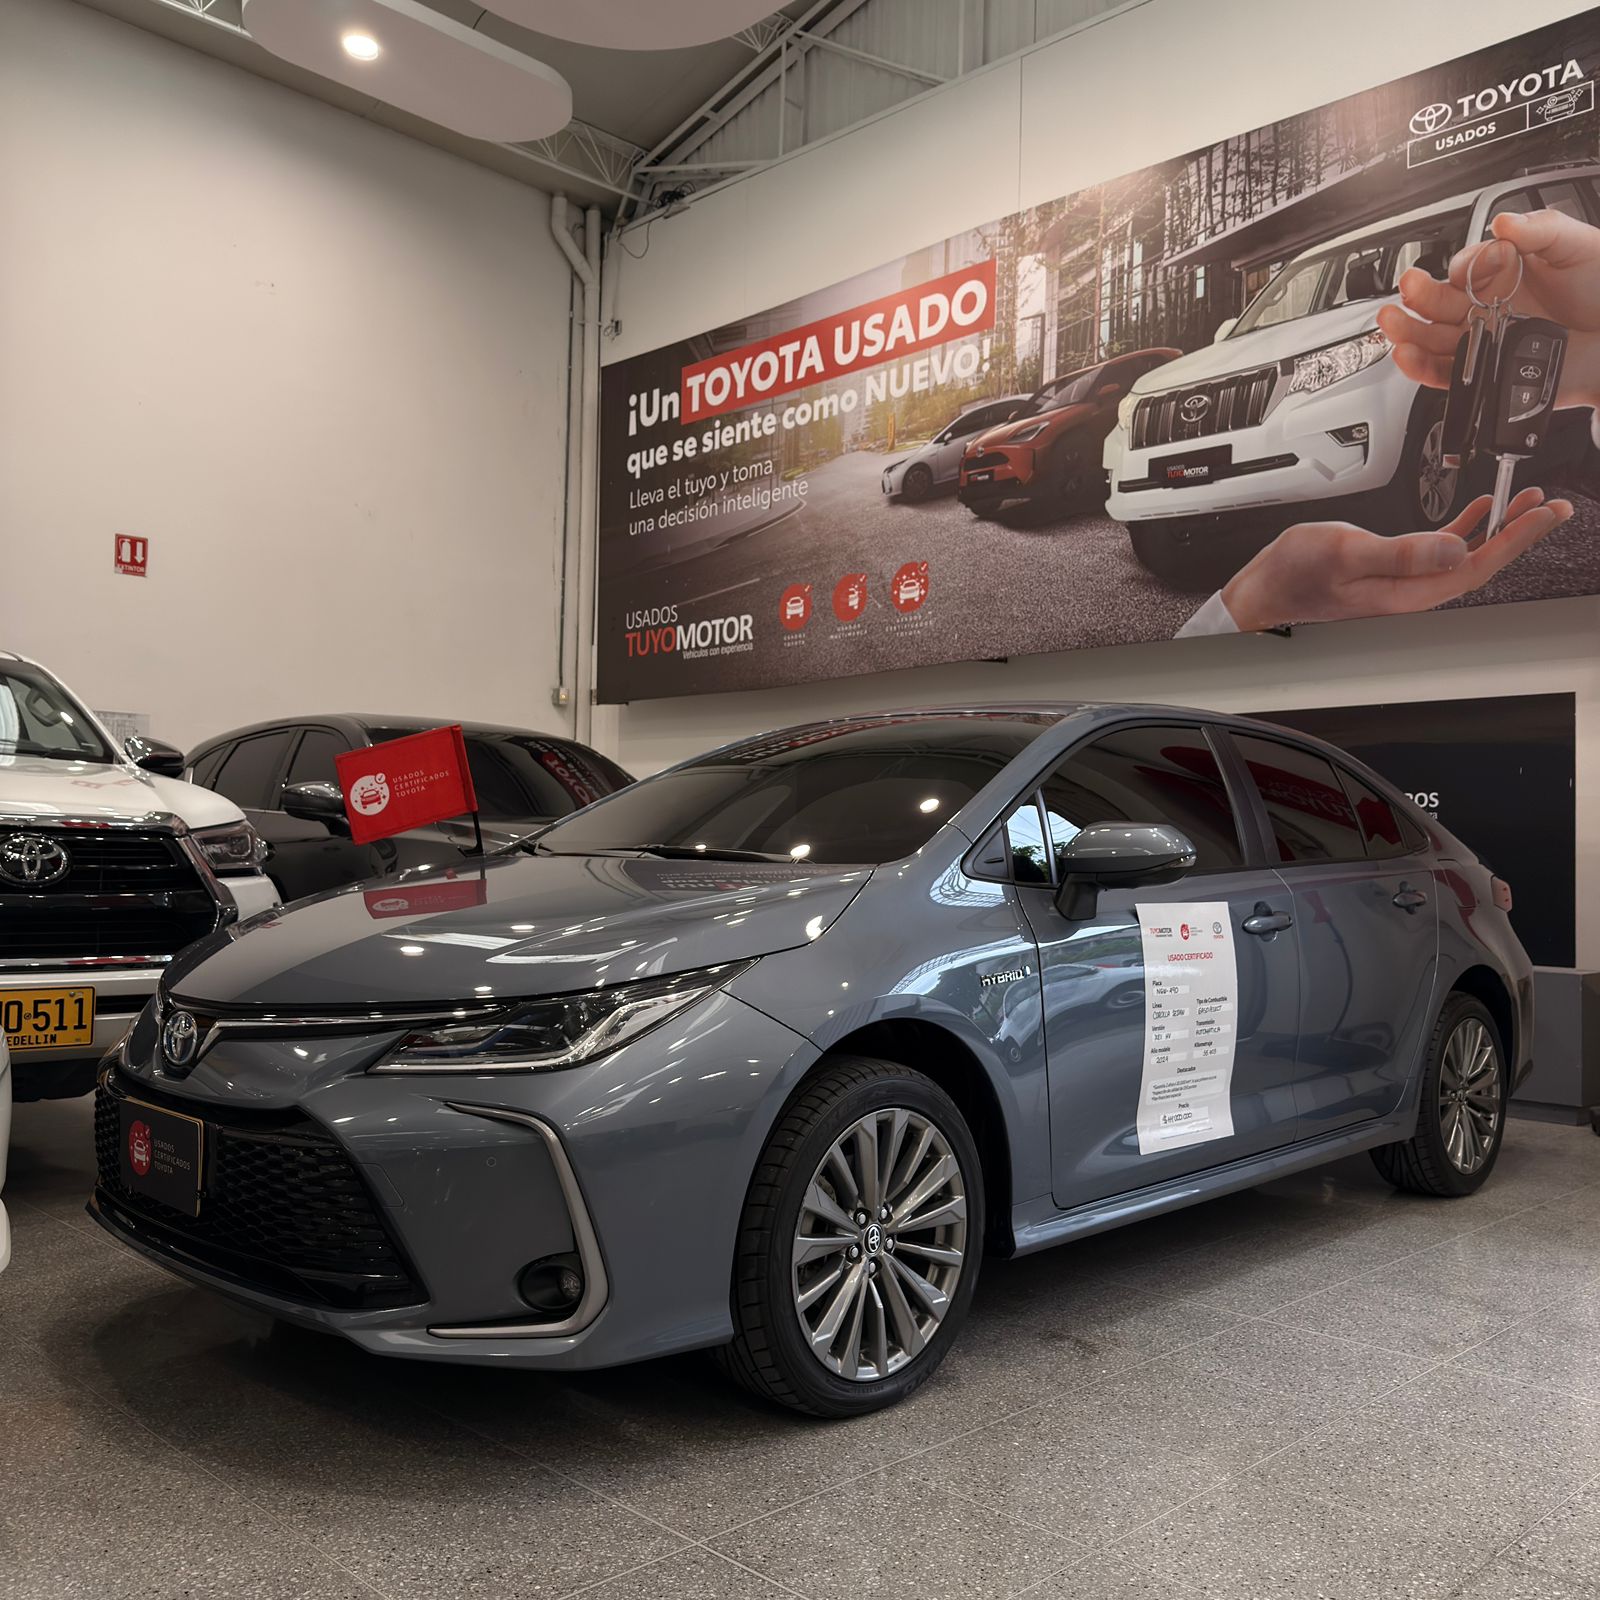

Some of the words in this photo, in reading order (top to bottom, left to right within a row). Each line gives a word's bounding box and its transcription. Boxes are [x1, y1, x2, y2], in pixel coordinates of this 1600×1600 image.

[1456, 58, 1584, 118] TOYOTA
[1435, 121, 1497, 151] USADOS
[628, 387, 680, 437] ¡Un
[686, 335, 825, 413] TOYOTA
[834, 279, 988, 366] USADO
[626, 444, 669, 480] que
[672, 436, 698, 462] se
[702, 411, 777, 454] siente
[782, 389, 858, 430] como
[865, 338, 991, 406] NUEVO!
[629, 488, 664, 510] Lleva
[668, 478, 681, 500] el
[684, 474, 717, 498] tuyo
[719, 471, 729, 491] y
[733, 459, 773, 483] toma
[629, 517, 655, 536] una
[658, 500, 719, 529] decisión
[722, 480, 809, 514] inteligente
[626, 604, 678, 630] USADOS
[625, 614, 754, 657] TUYOMOTOR
[709, 647, 720, 657] con
[721, 642, 754, 656] experiencia
[393, 770, 425, 784] USADOS
[394, 770, 449, 791] CERTIFICADOS
[396, 785, 426, 798] TOYOTA
[1167, 952, 1184, 962] USADO
[1184, 951, 1214, 961] CERTIFICADO
[981, 967, 1025, 987] HYBRID
[32, 997, 88, 1032] 511
[154, 1138, 175, 1153] USADOS
[154, 1150, 191, 1171] CERTIFICADOS
[154, 1161, 174, 1174] TOYOTA
